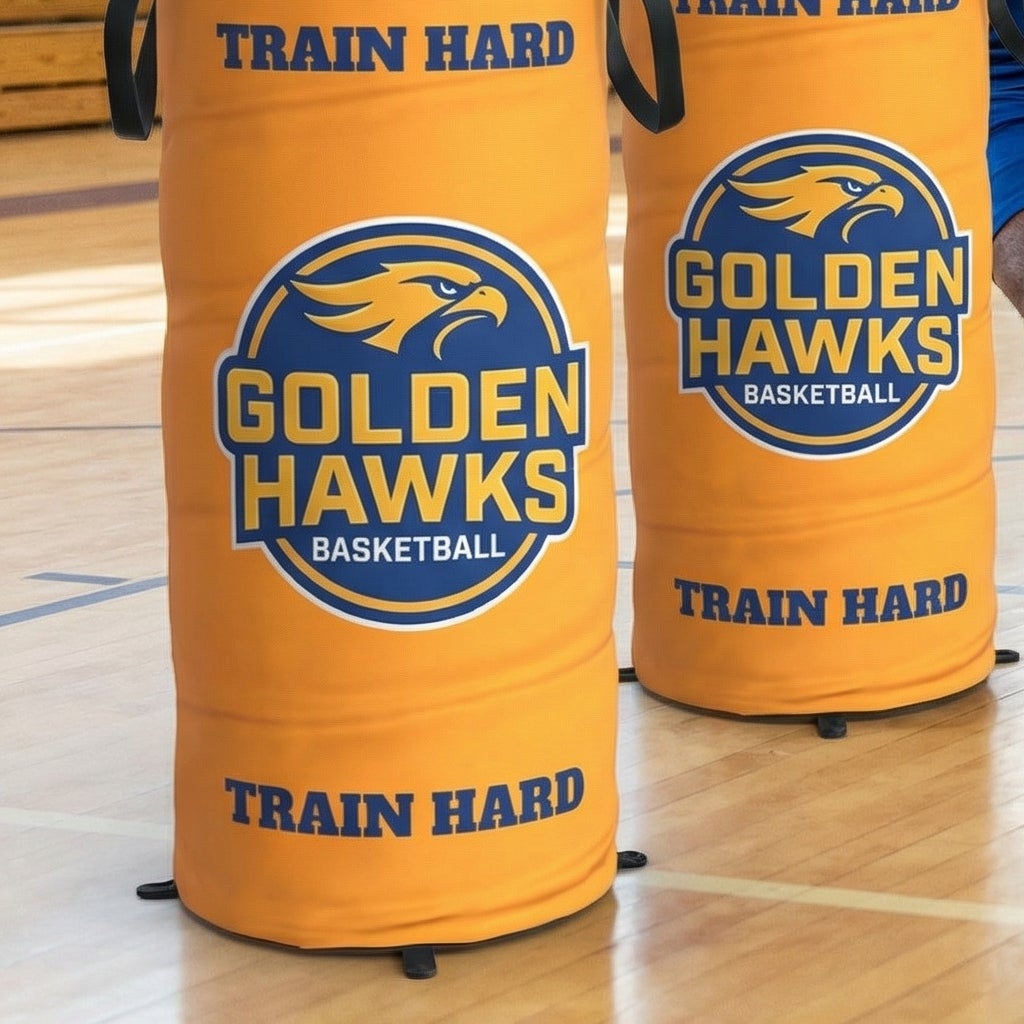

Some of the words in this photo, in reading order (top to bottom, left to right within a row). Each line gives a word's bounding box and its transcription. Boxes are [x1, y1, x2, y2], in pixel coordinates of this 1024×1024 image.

[217, 23, 407, 72] TRAIN
[425, 20, 575, 72] HARD
[675, 247, 963, 310] GOLDEN
[689, 315, 952, 378] HAWKS
[226, 362, 579, 445] GOLDEN
[744, 383, 901, 405] BASKETBALL
[243, 449, 567, 531] HAWKS
[312, 533, 505, 562] BASKETBALL
[674, 578, 828, 626] TRAIN
[842, 573, 968, 625] HARD
[225, 777, 415, 838] TRAIN
[432, 766, 584, 836] HARD
